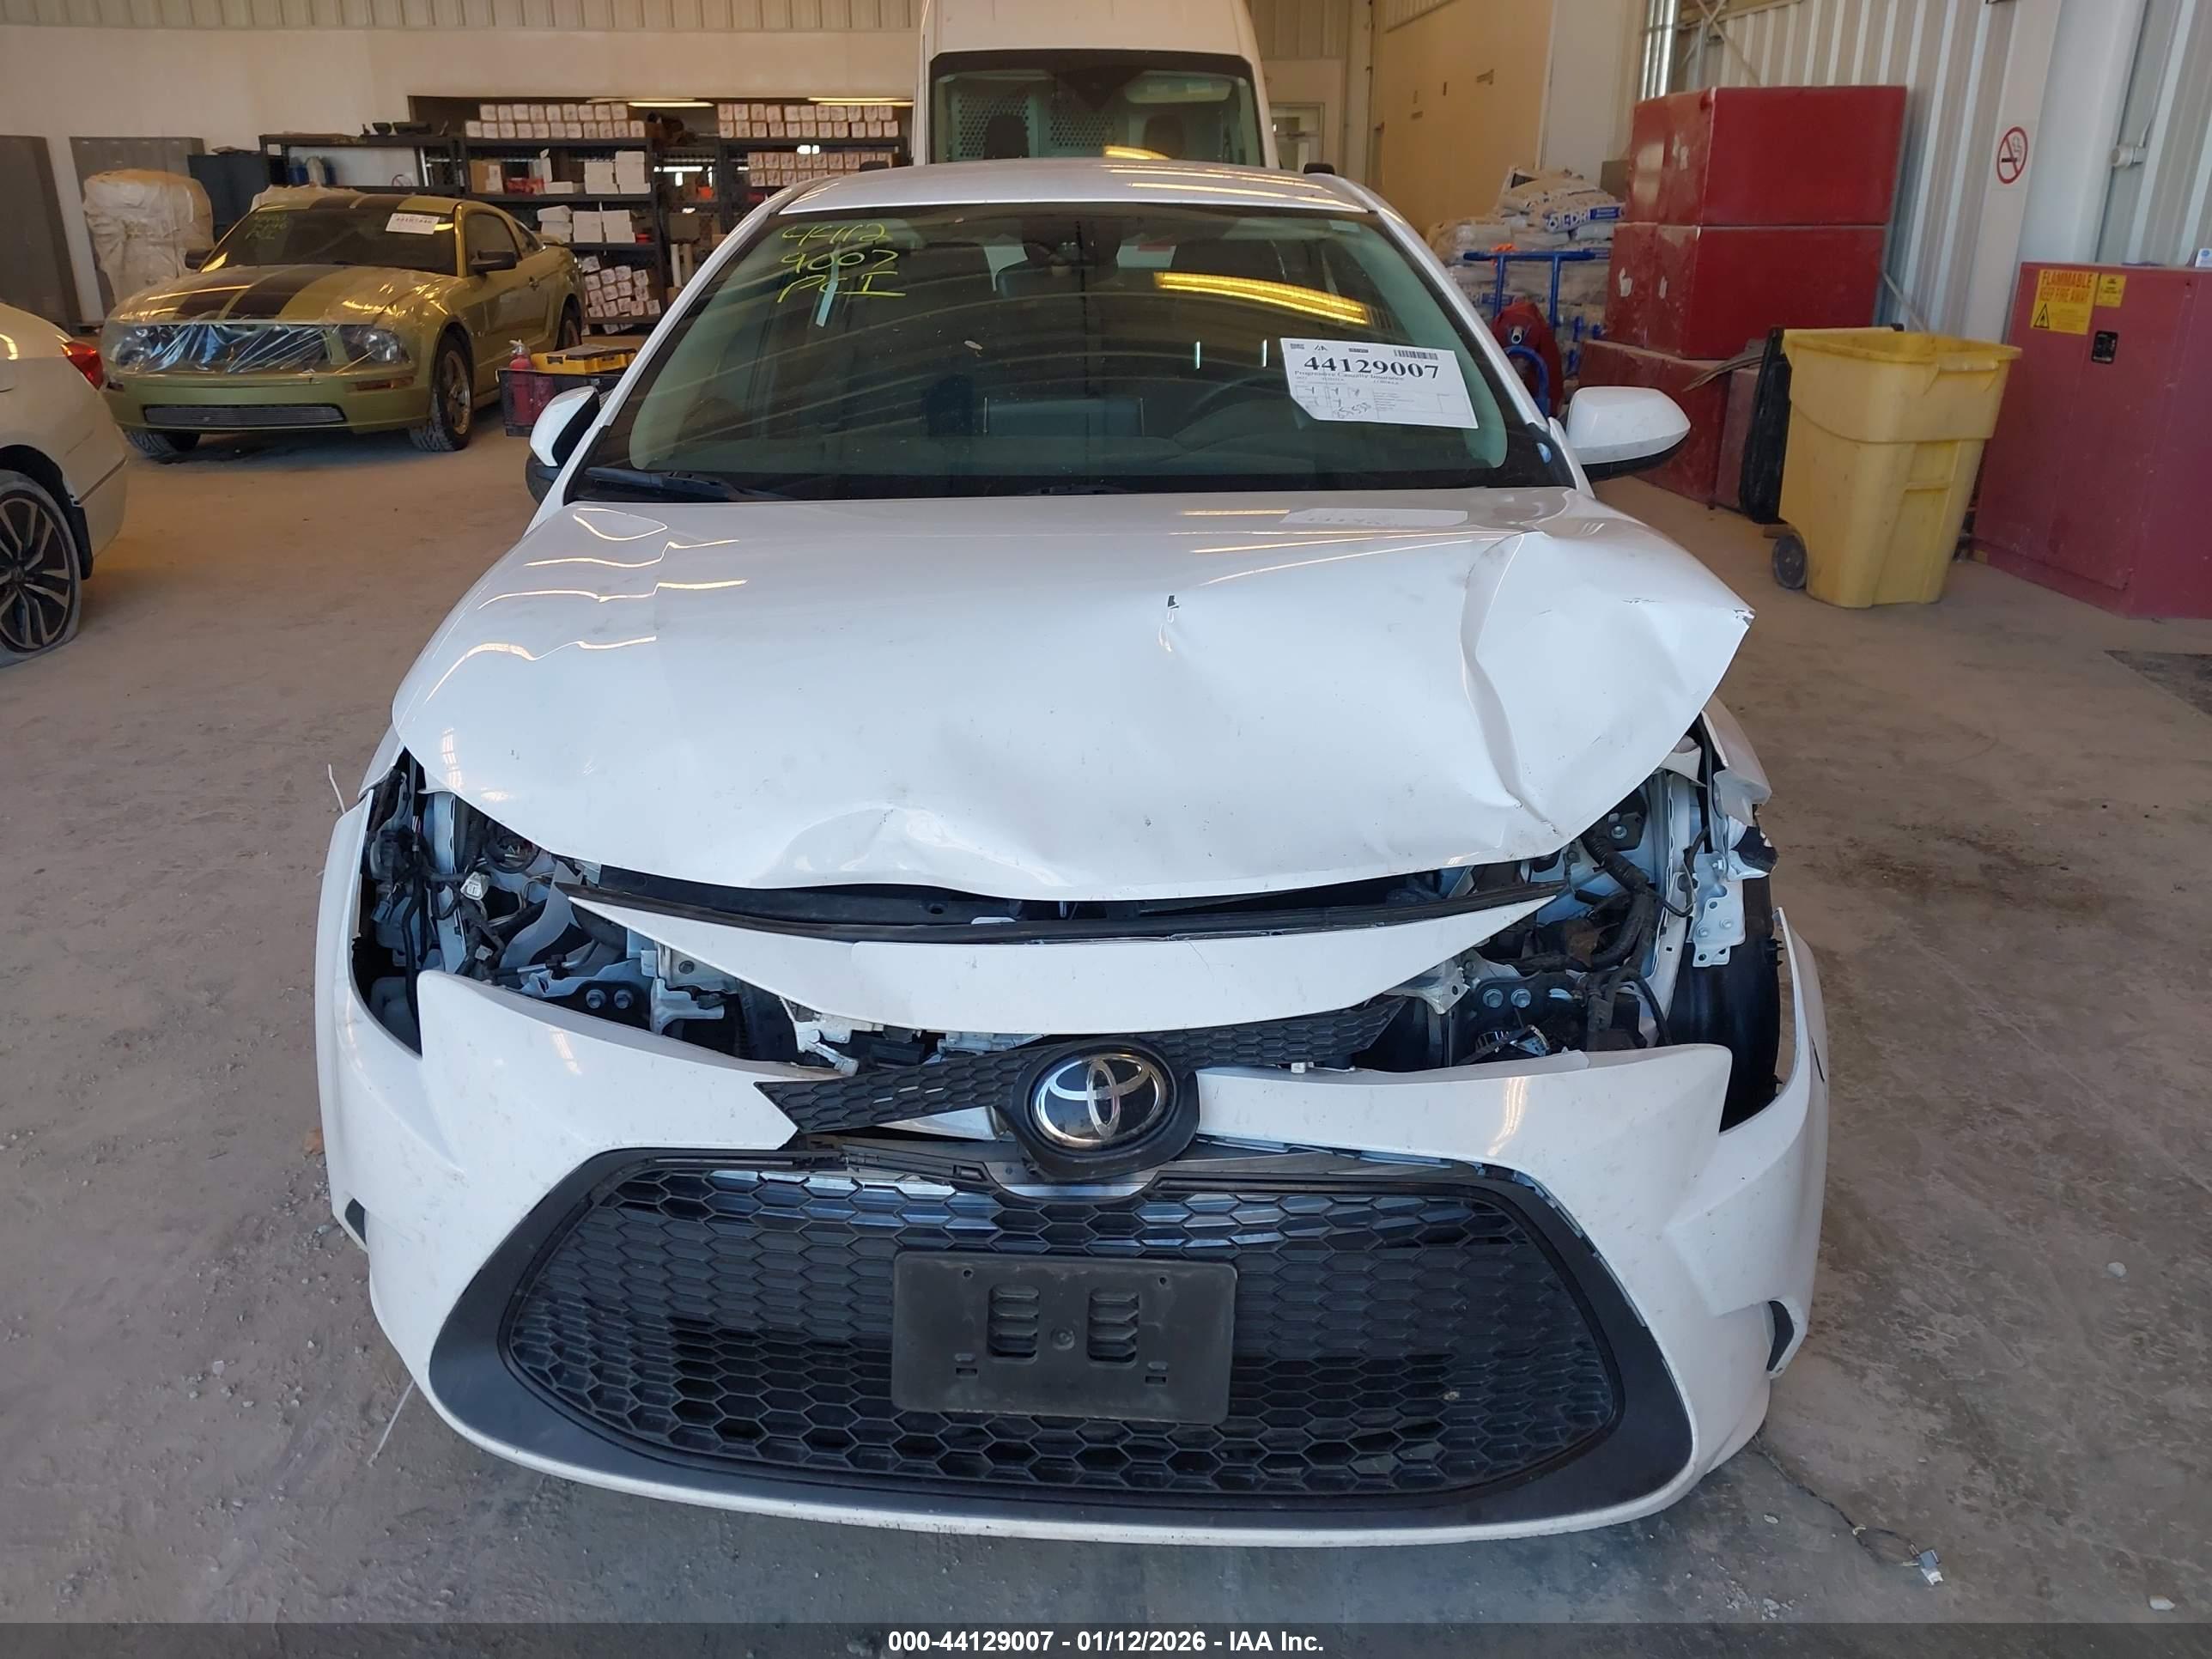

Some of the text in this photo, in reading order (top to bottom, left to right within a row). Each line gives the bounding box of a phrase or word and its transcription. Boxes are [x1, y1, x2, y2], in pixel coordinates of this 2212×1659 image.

[781, 249, 899, 274] 9007
[2040, 270, 2093, 289] FLAMMABLE
[2054, 288, 2070, 301] FIRE
[1304, 356, 1439, 380] 44129007
